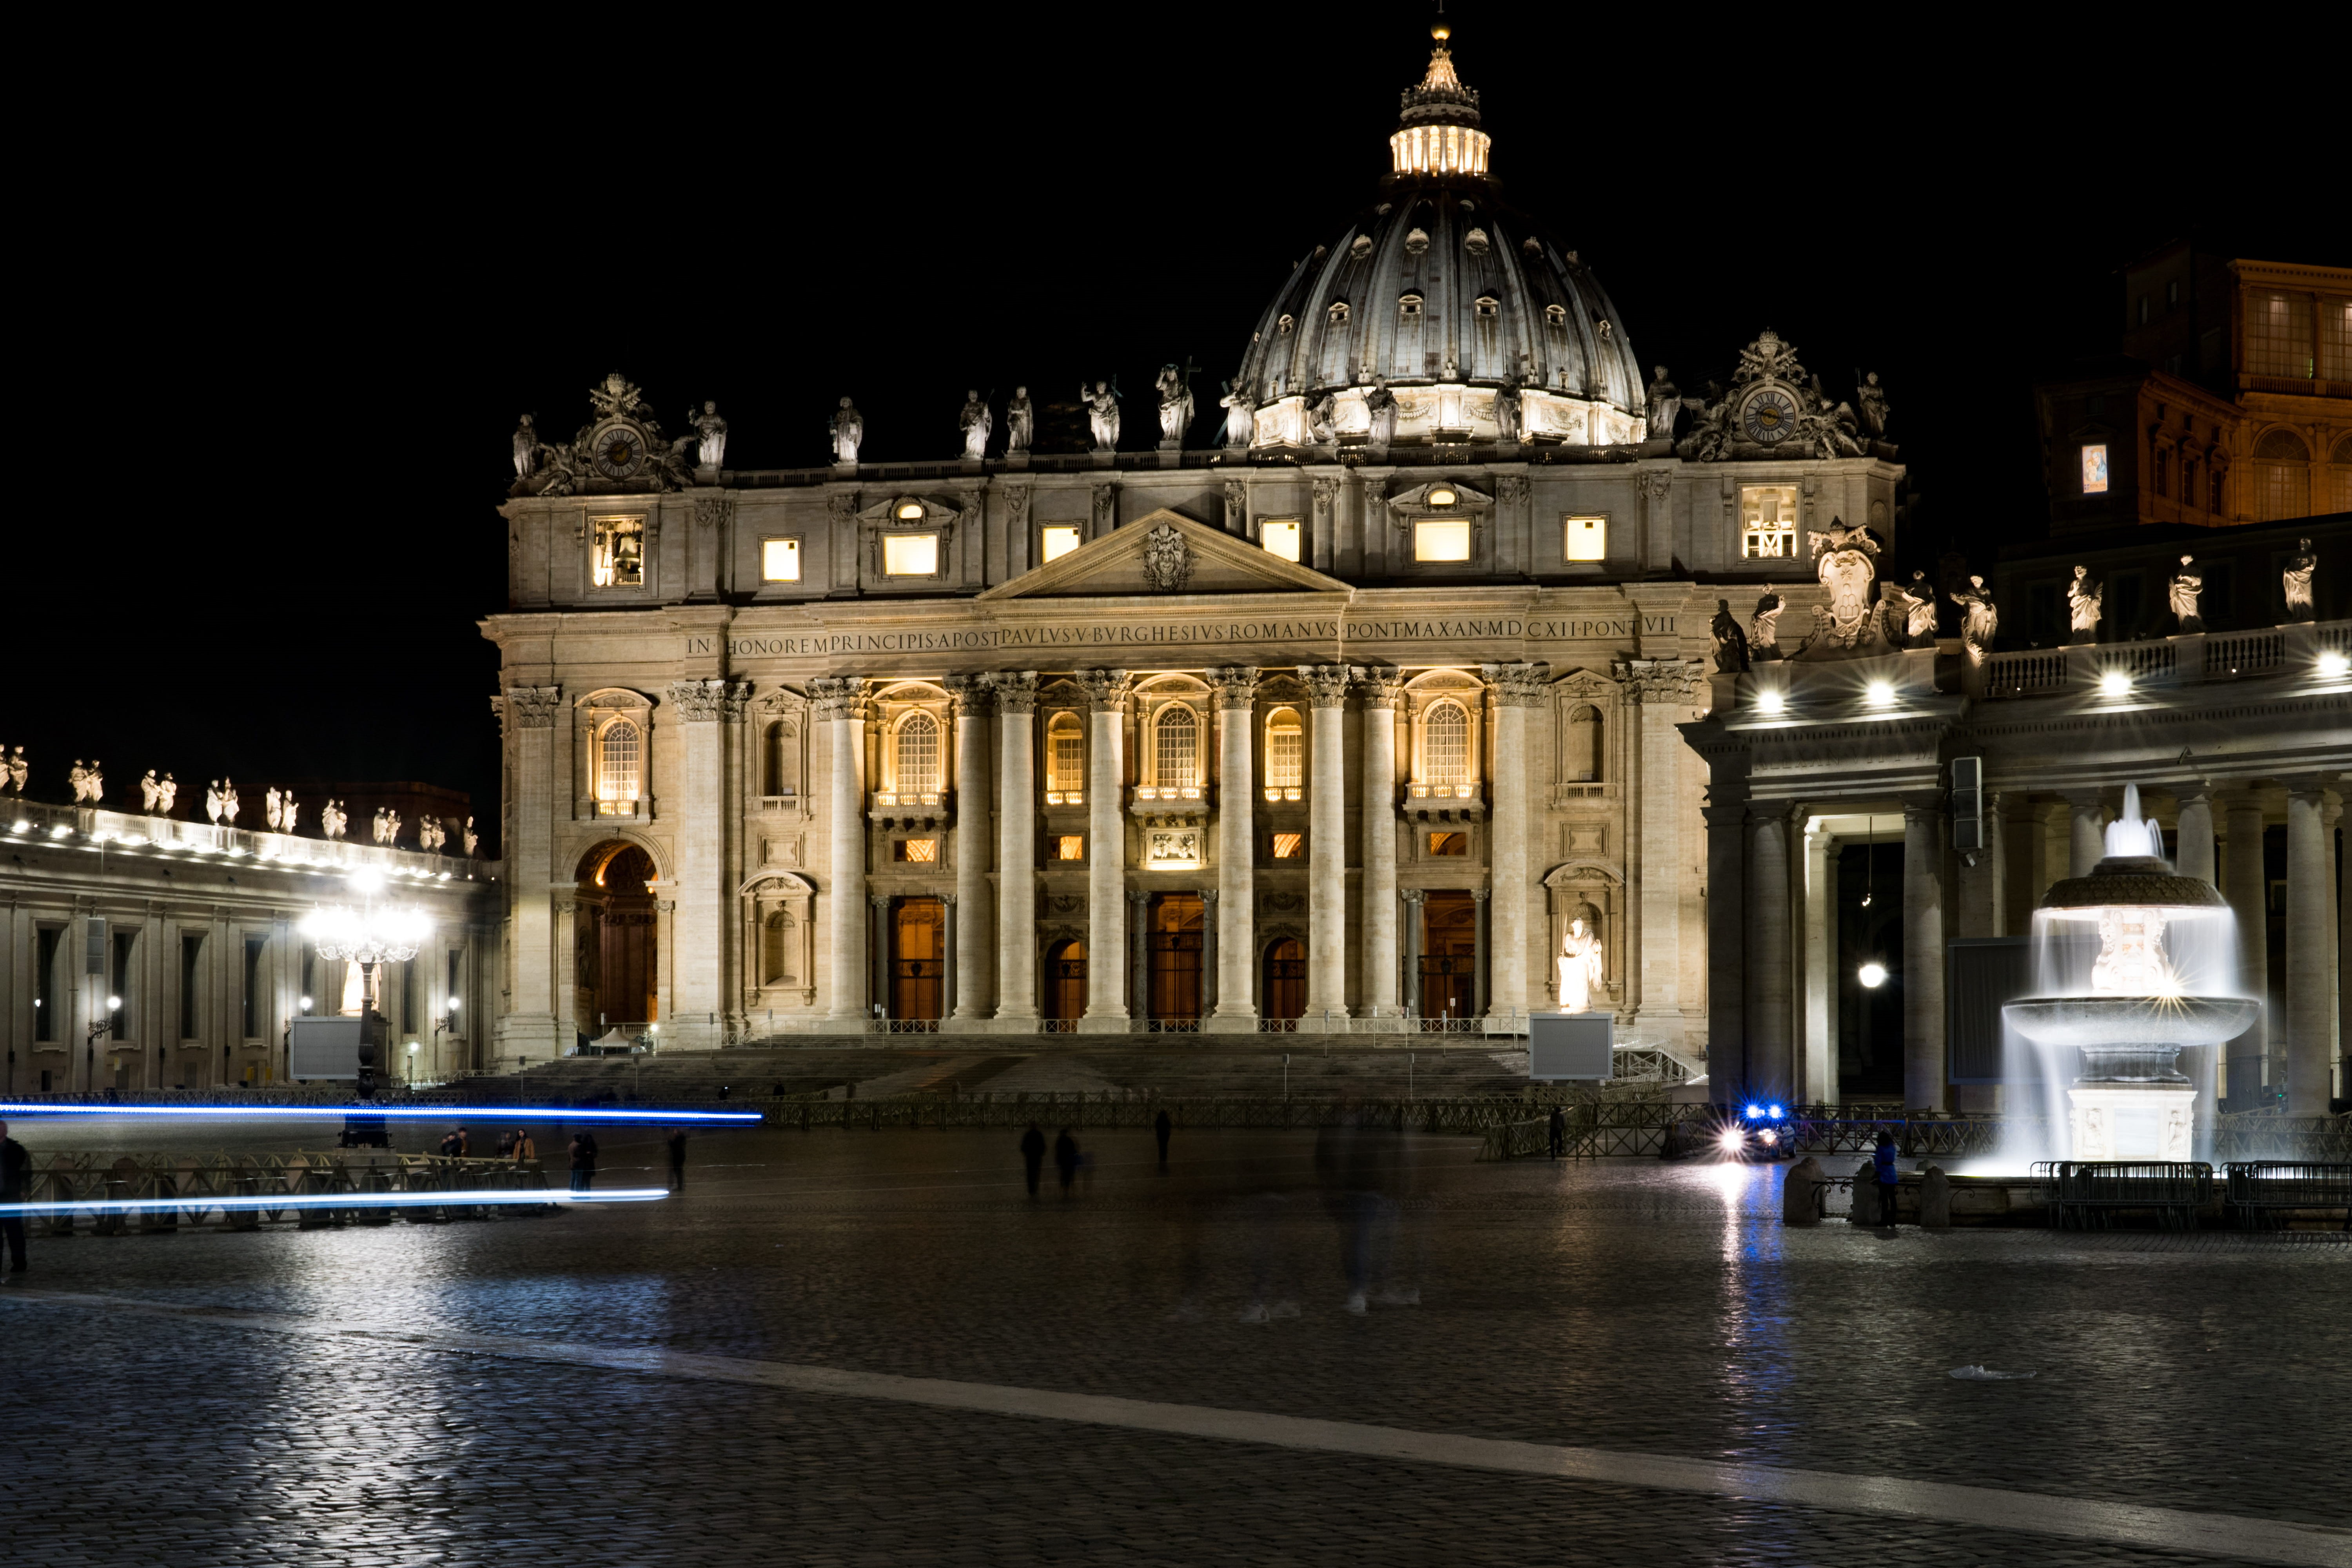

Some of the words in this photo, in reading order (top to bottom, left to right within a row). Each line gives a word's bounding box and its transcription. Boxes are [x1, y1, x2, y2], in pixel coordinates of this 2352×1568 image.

[687, 638, 711, 653] IN
[726, 638, 828, 655] HONOREM
[830, 633, 933, 650] PRINCIPIS
[937, 631, 1000, 648] APOST
[1001, 627, 1071, 644] PAVLVS
[1075, 627, 1089, 642] V
[1093, 624, 1223, 642] BVRGHESIVS
[1229, 621, 1338, 640] ROMANVS
[1347, 622, 1402, 638] PONT
[1403, 621, 1451, 637] MAX
[1454, 621, 1483, 637] AN
[1582, 619, 1640, 637] PONT
[1644, 617, 1675, 632] VII
